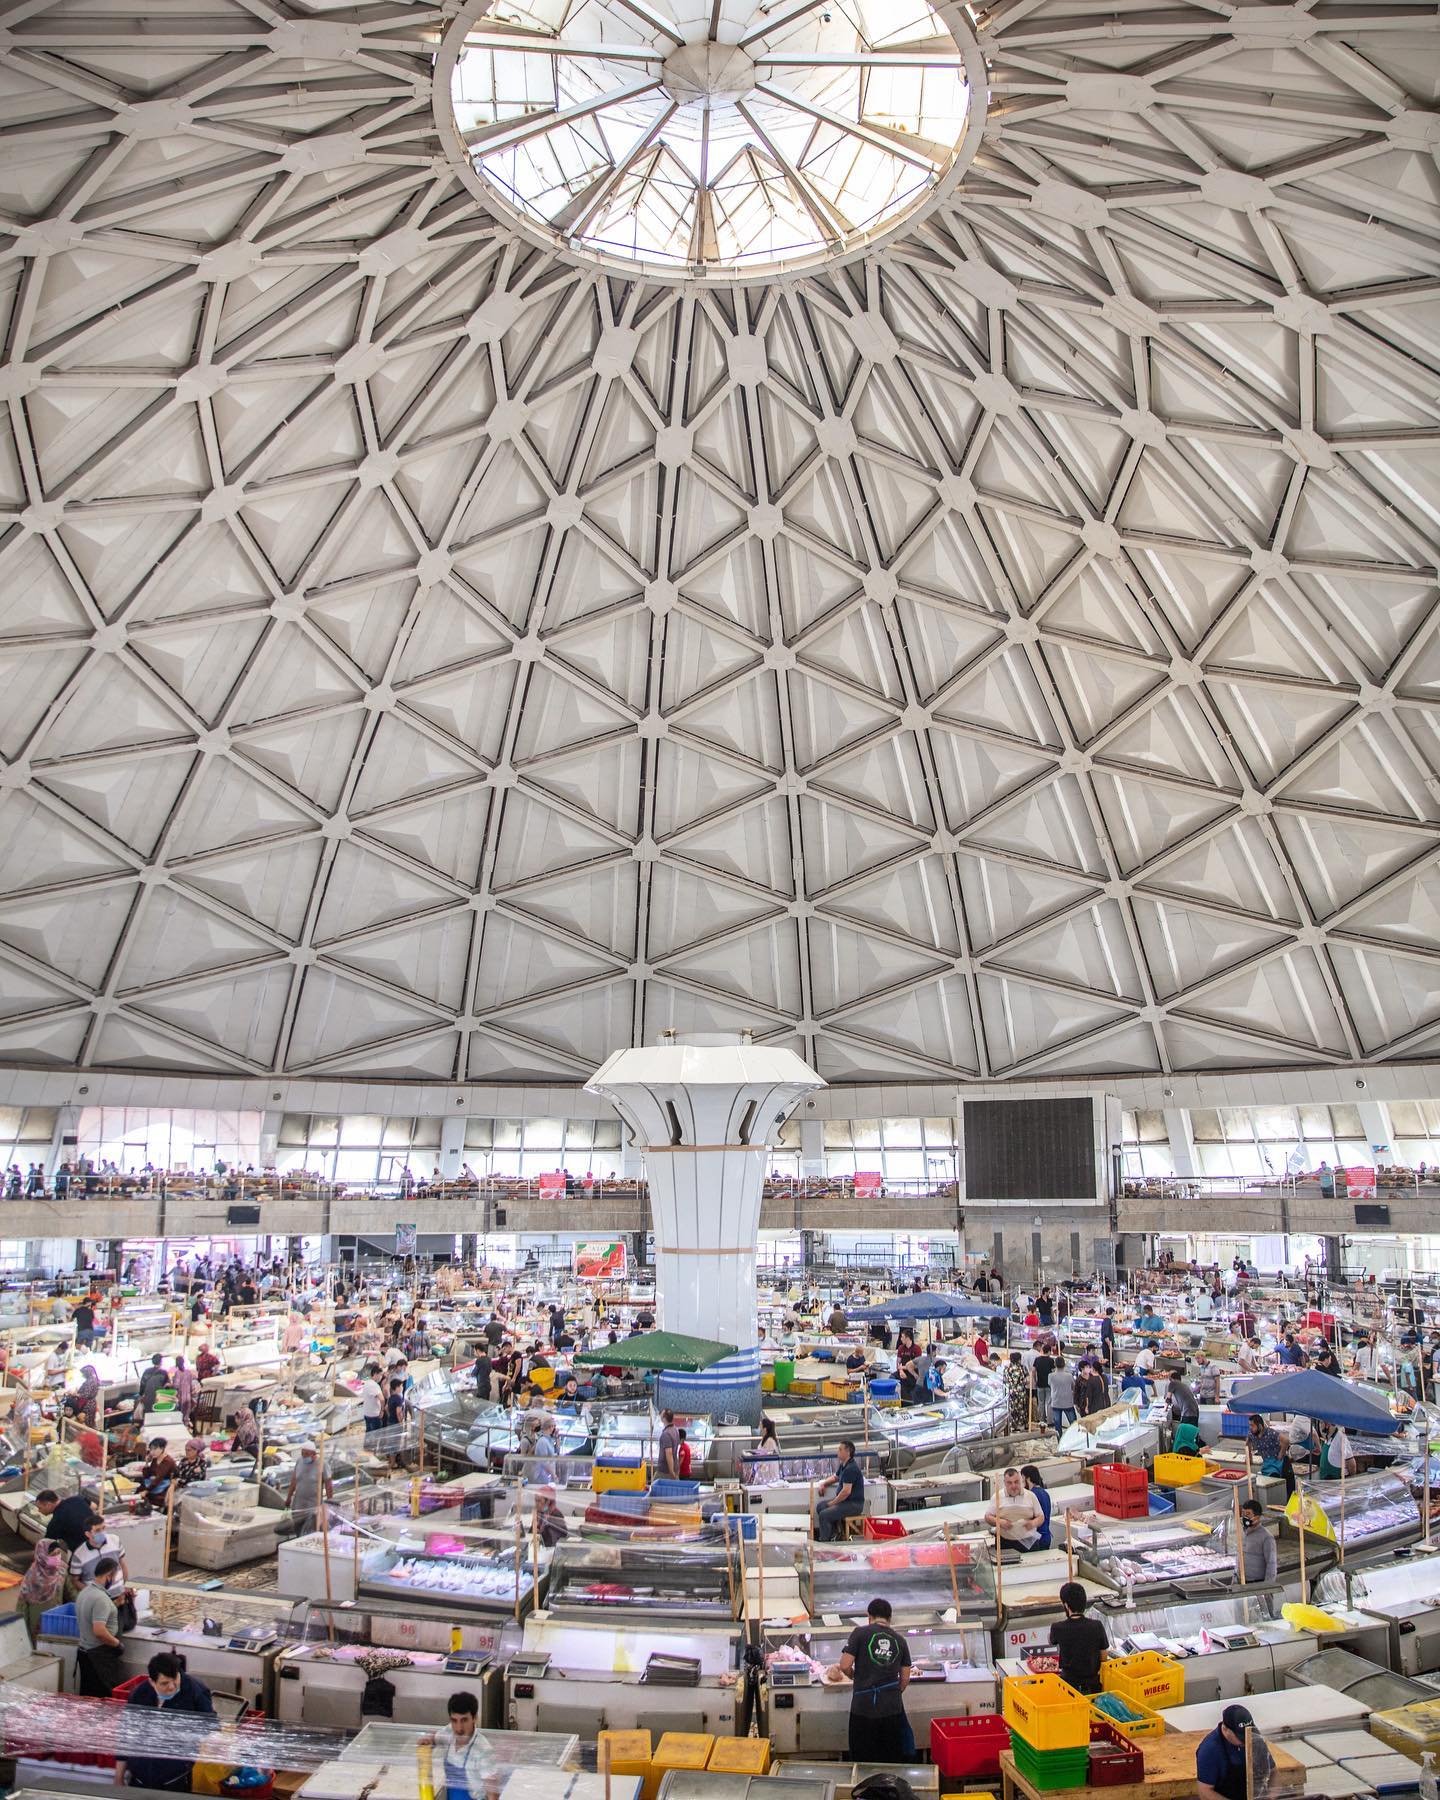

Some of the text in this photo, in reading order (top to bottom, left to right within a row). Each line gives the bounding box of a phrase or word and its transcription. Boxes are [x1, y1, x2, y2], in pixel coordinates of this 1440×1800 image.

[1010, 1633, 1026, 1645] 90
[874, 1648, 893, 1657] UFC
[1143, 1682, 1170, 1697] WIBERG
[1012, 1698, 1029, 1721] WIBERG
